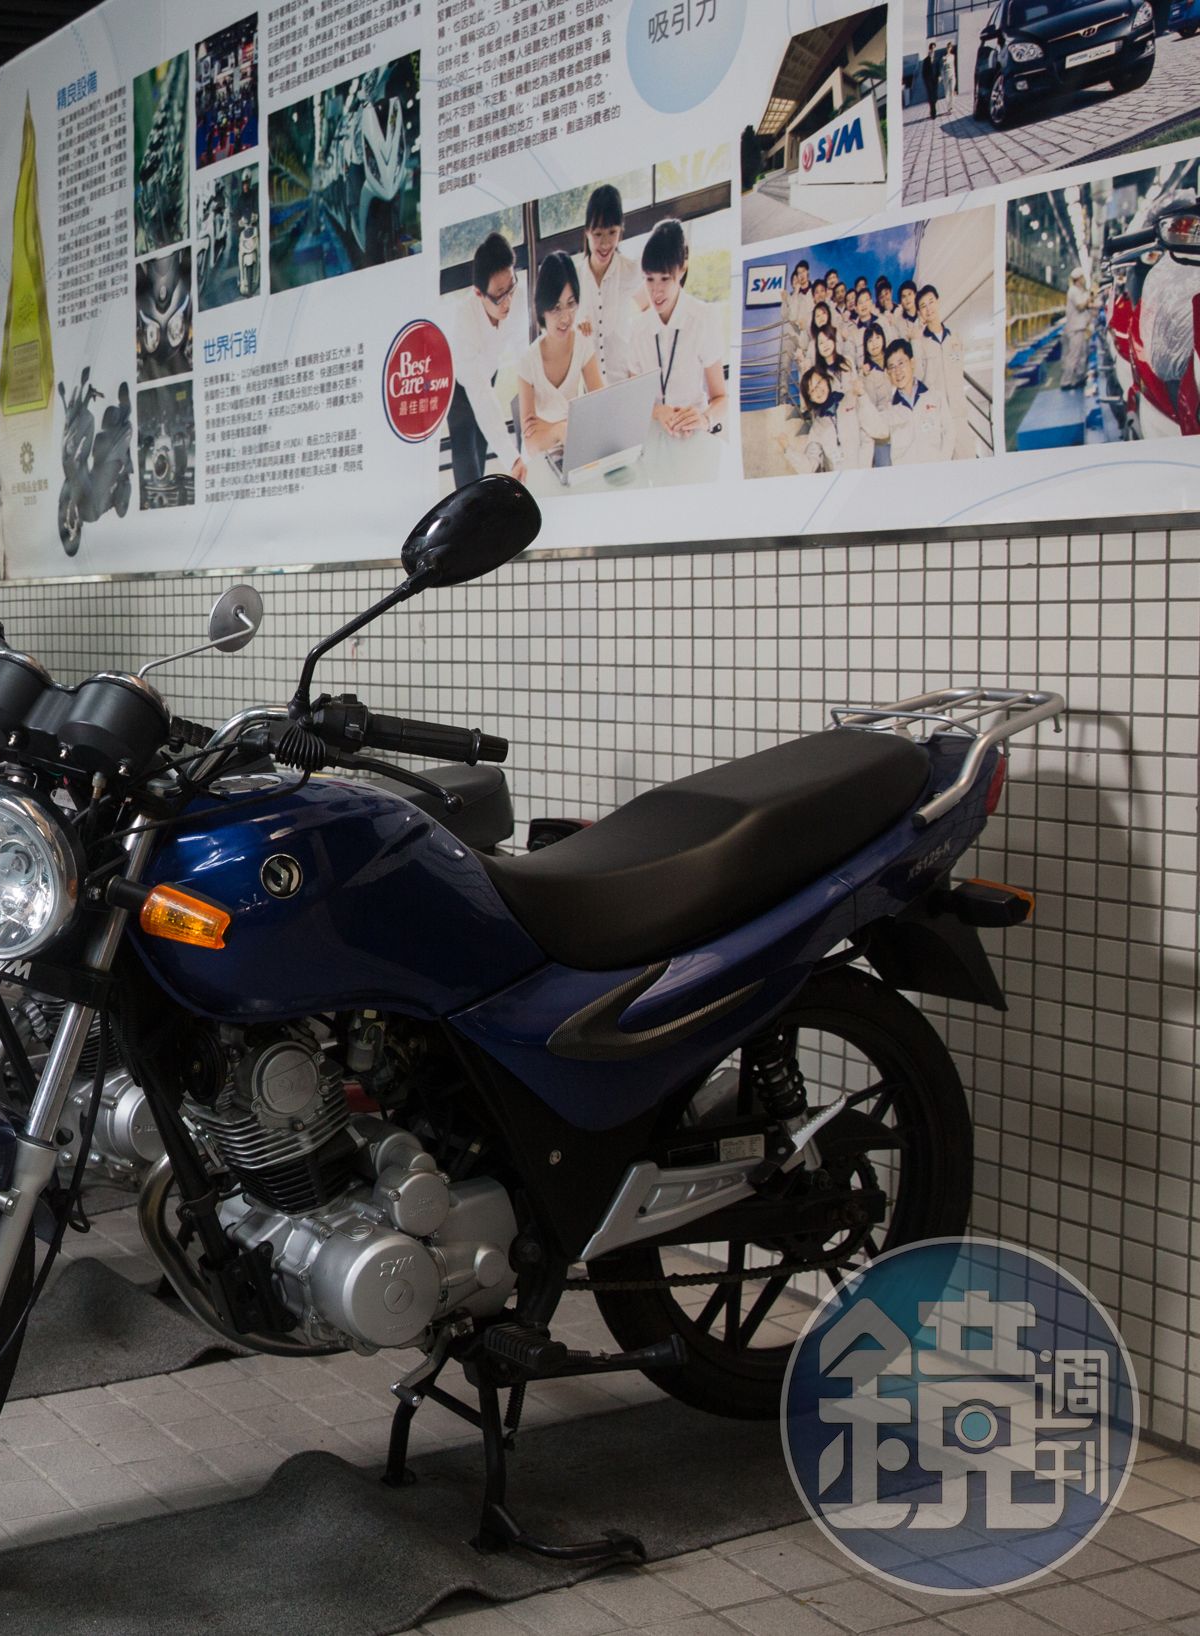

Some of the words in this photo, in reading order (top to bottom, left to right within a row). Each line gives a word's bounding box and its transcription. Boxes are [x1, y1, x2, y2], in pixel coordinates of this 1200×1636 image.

[647, 0, 717, 44] 吸引力
[816, 117, 864, 163] SYM
[751, 276, 782, 292] SYM
[203, 328, 257, 364] 世界行銷
[400, 351, 431, 378] Best
[390, 372, 424, 398] Care
[429, 377, 449, 392] SYM
